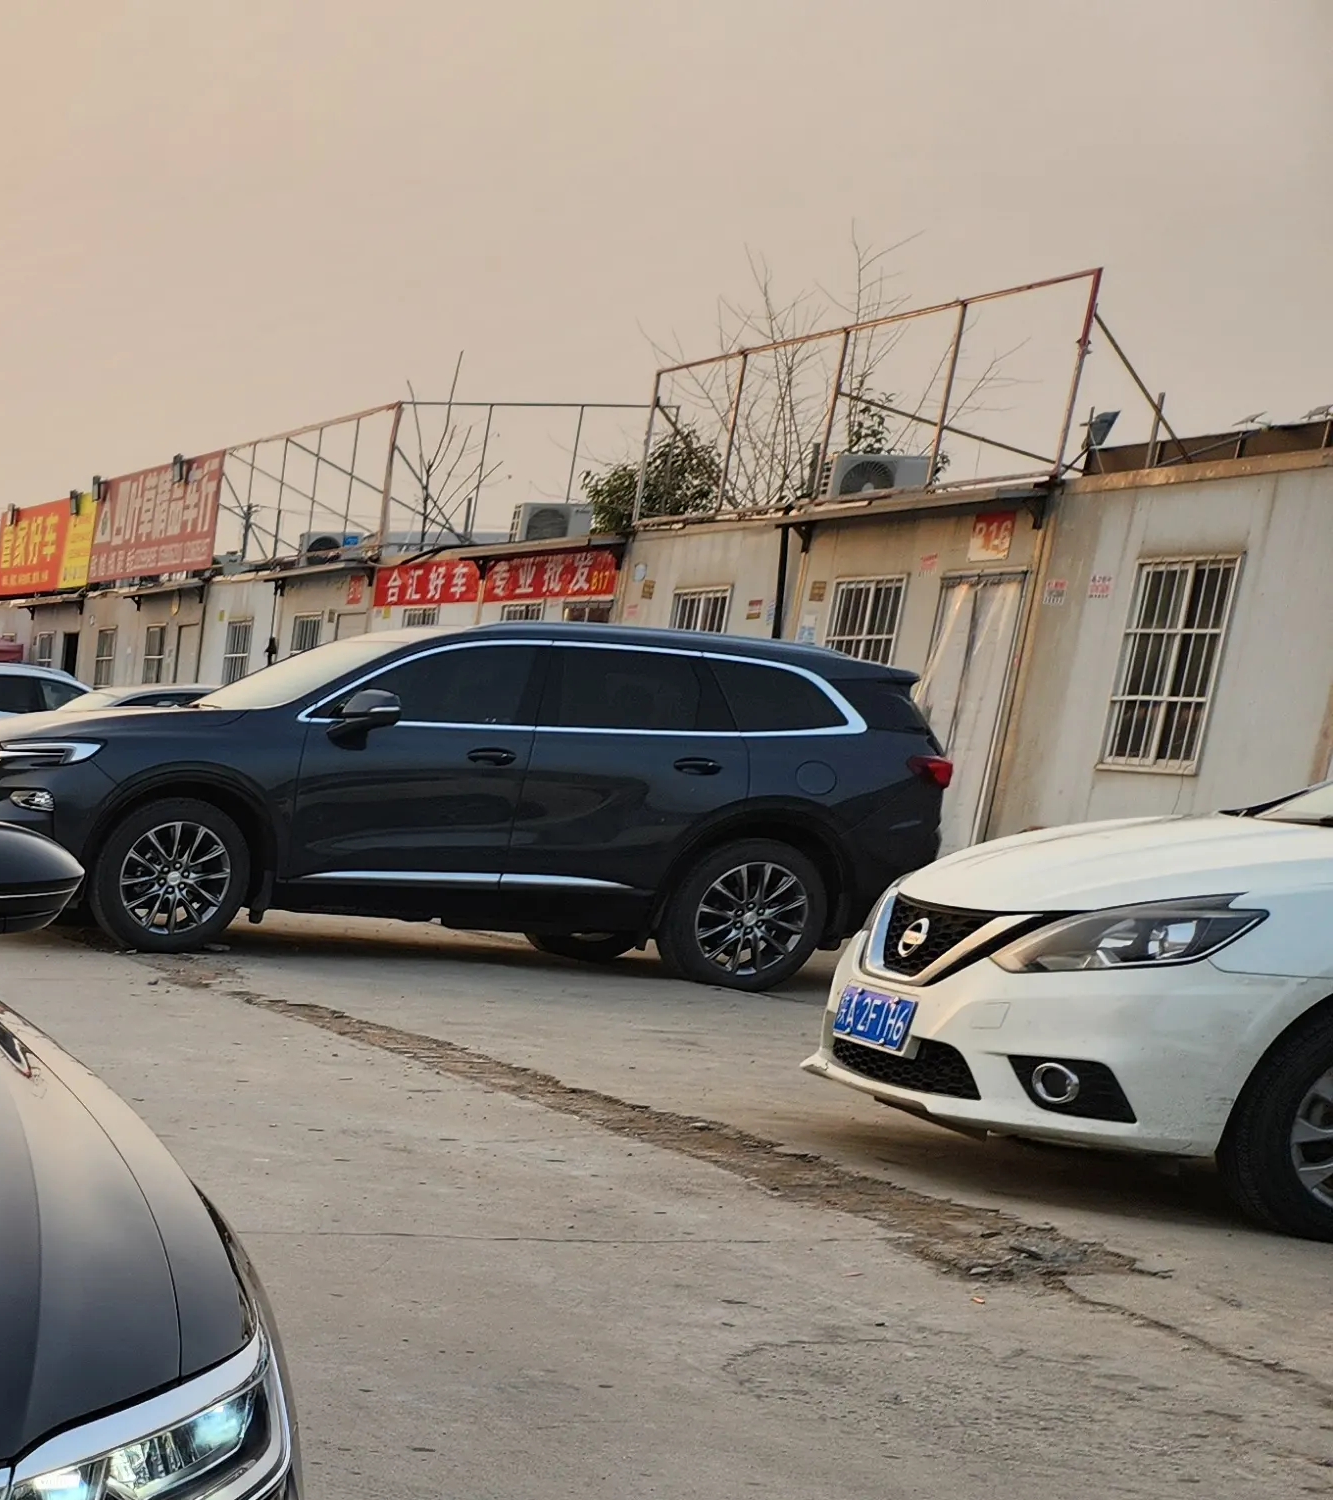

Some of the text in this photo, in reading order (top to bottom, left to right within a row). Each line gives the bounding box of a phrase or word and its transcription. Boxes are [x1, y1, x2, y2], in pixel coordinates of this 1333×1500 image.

[385, 563, 470, 603] 合汇好车
[491, 551, 594, 597] 专业批发
[590, 569, 610, 592] B17
